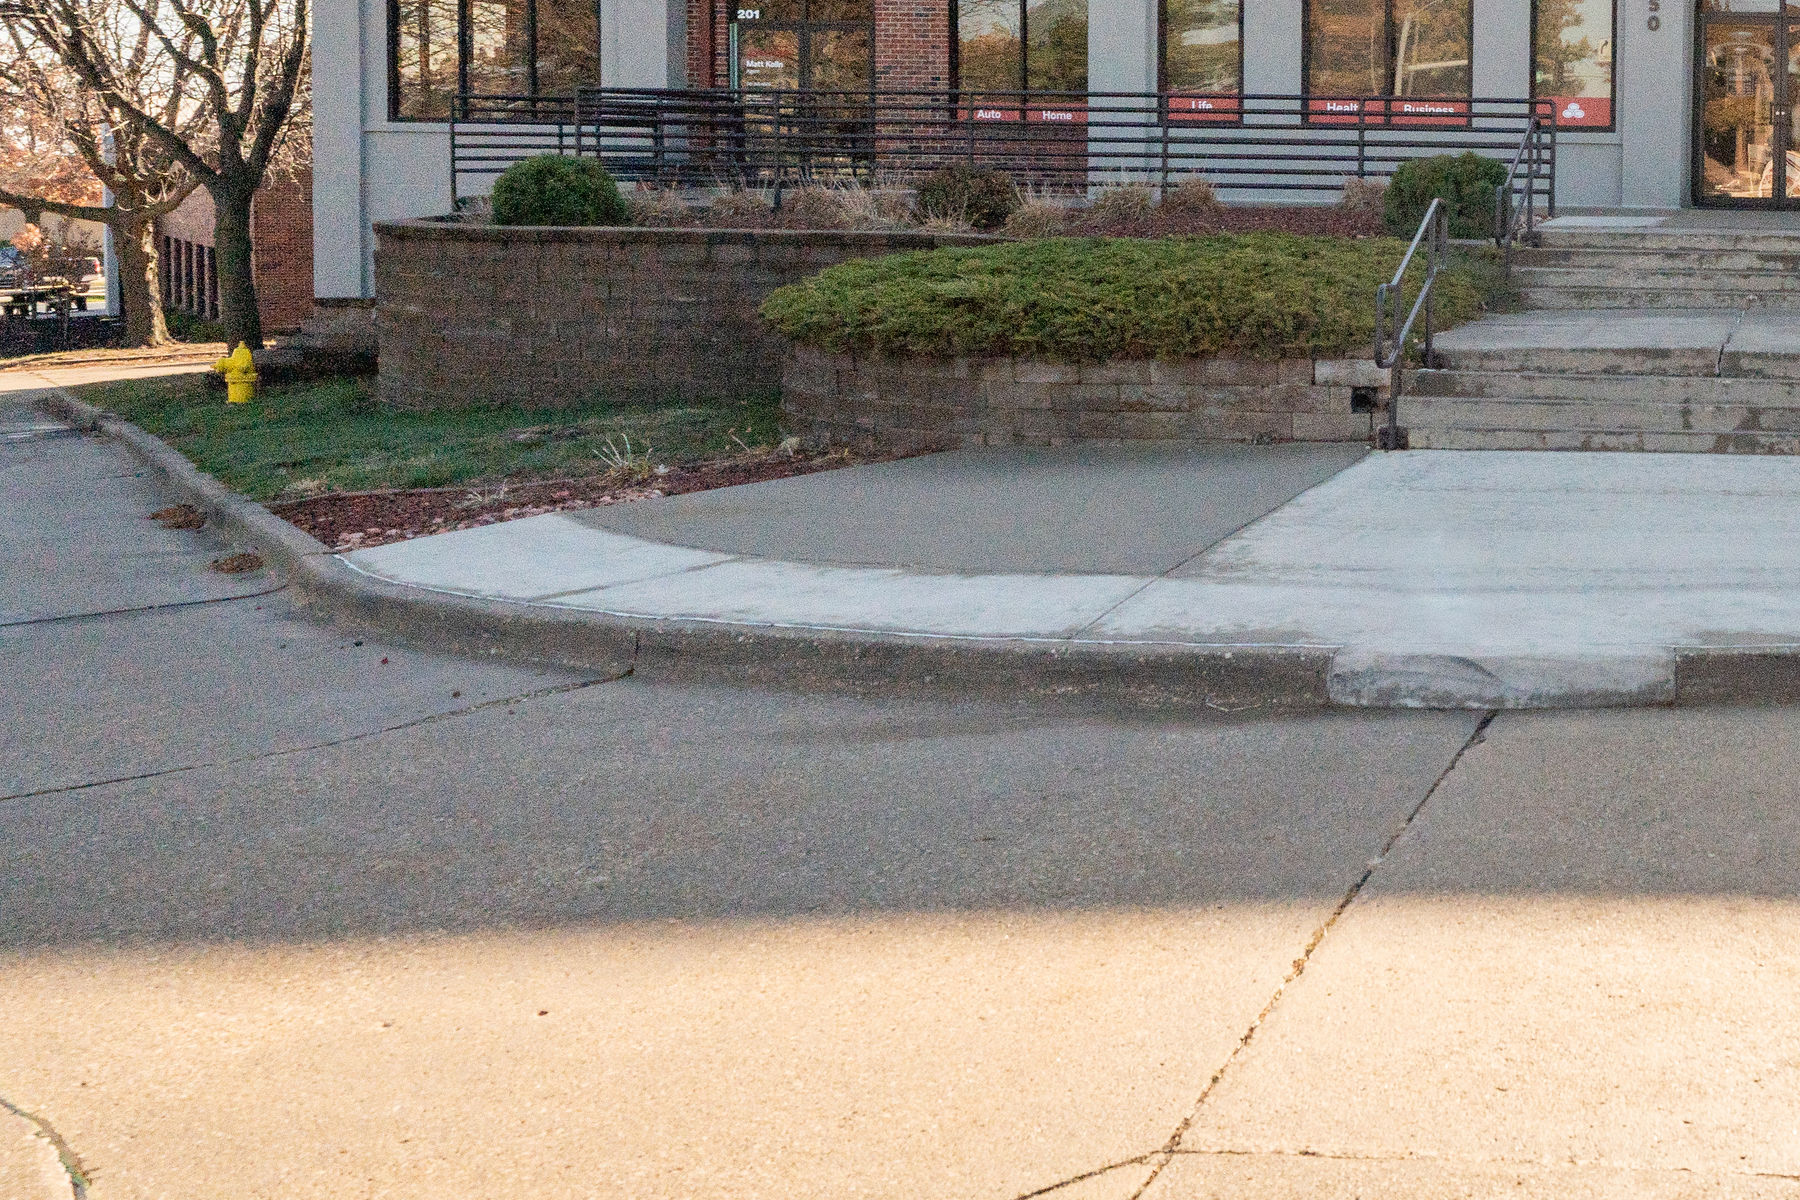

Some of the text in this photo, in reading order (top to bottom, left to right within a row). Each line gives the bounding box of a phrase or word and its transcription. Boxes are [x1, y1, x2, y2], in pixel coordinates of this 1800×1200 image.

[737, 9, 760, 19] 201
[1326, 102, 1359, 112] Healt
[977, 109, 1001, 119] Auto
[1042, 110, 1072, 120] Home
